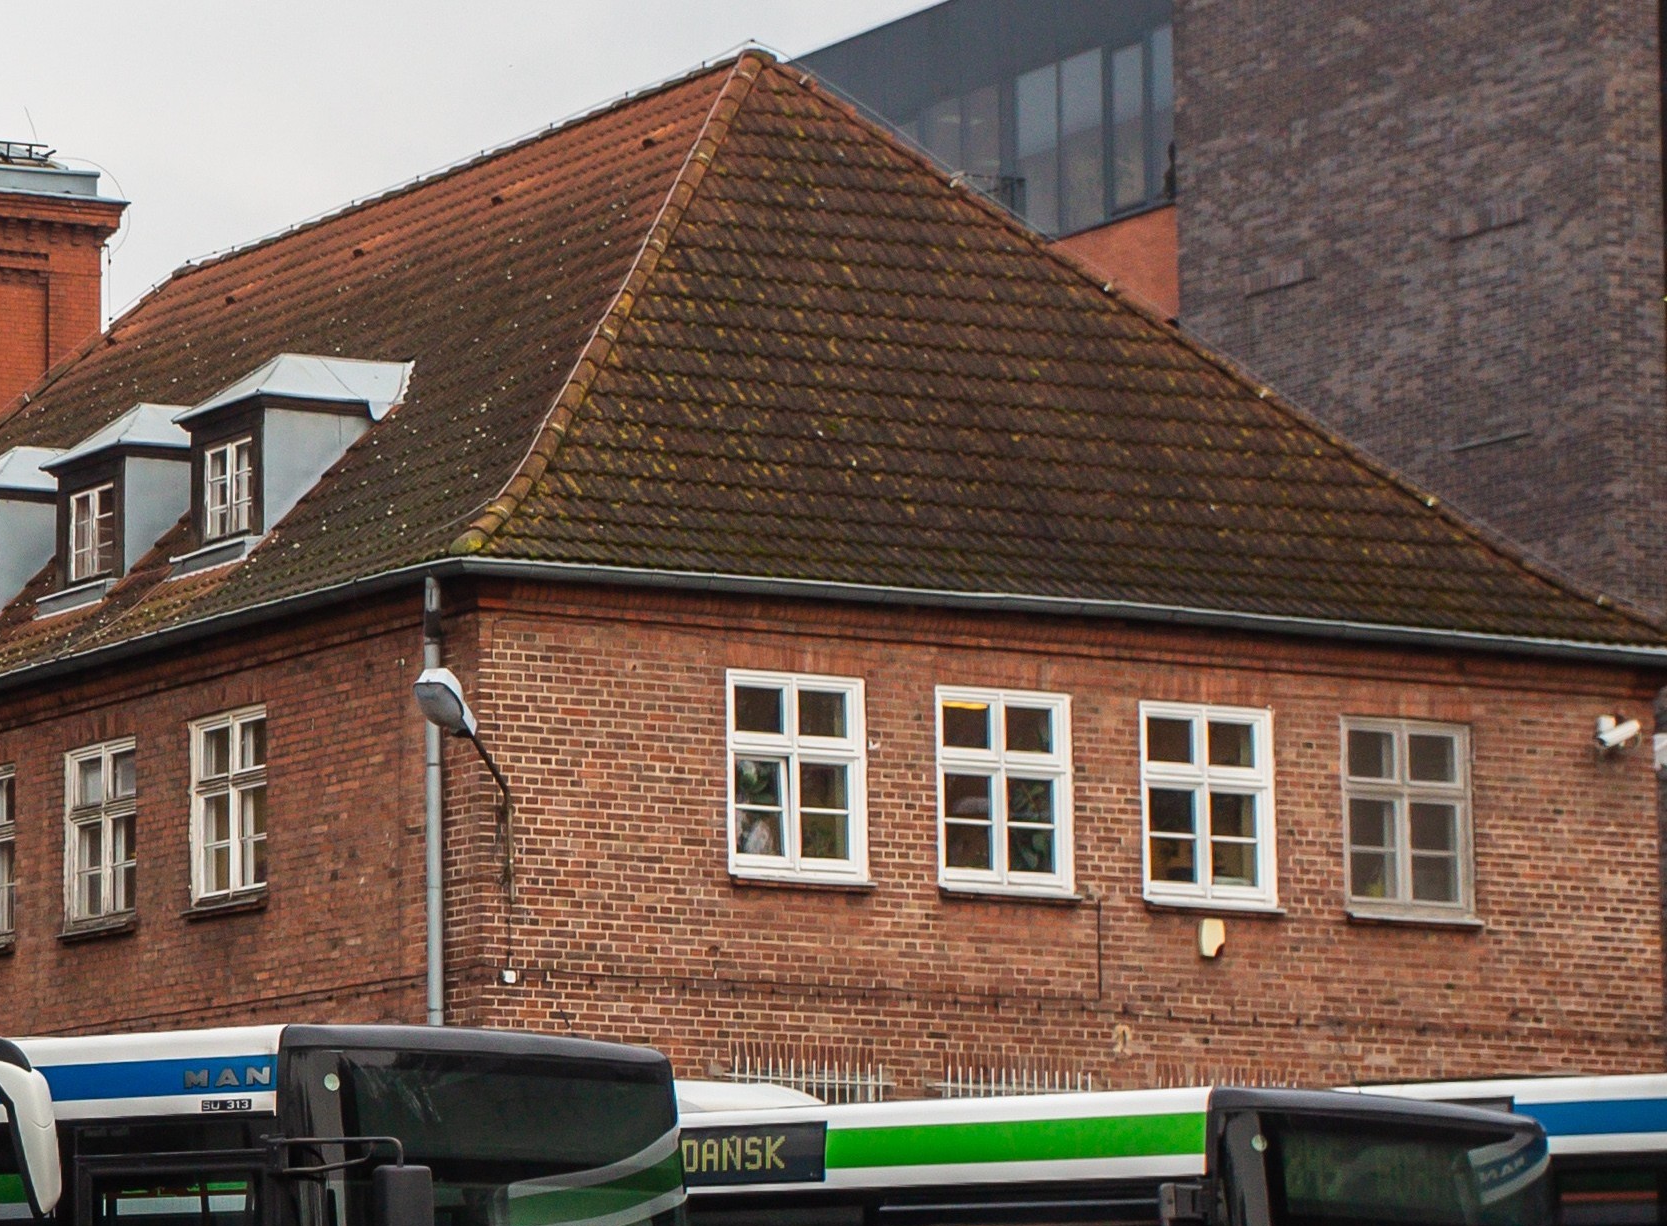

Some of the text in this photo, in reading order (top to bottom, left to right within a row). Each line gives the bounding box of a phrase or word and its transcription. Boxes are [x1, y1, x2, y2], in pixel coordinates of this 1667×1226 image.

[184, 1066, 271, 1088] MAN
[202, 1100, 249, 1110] SU 313
